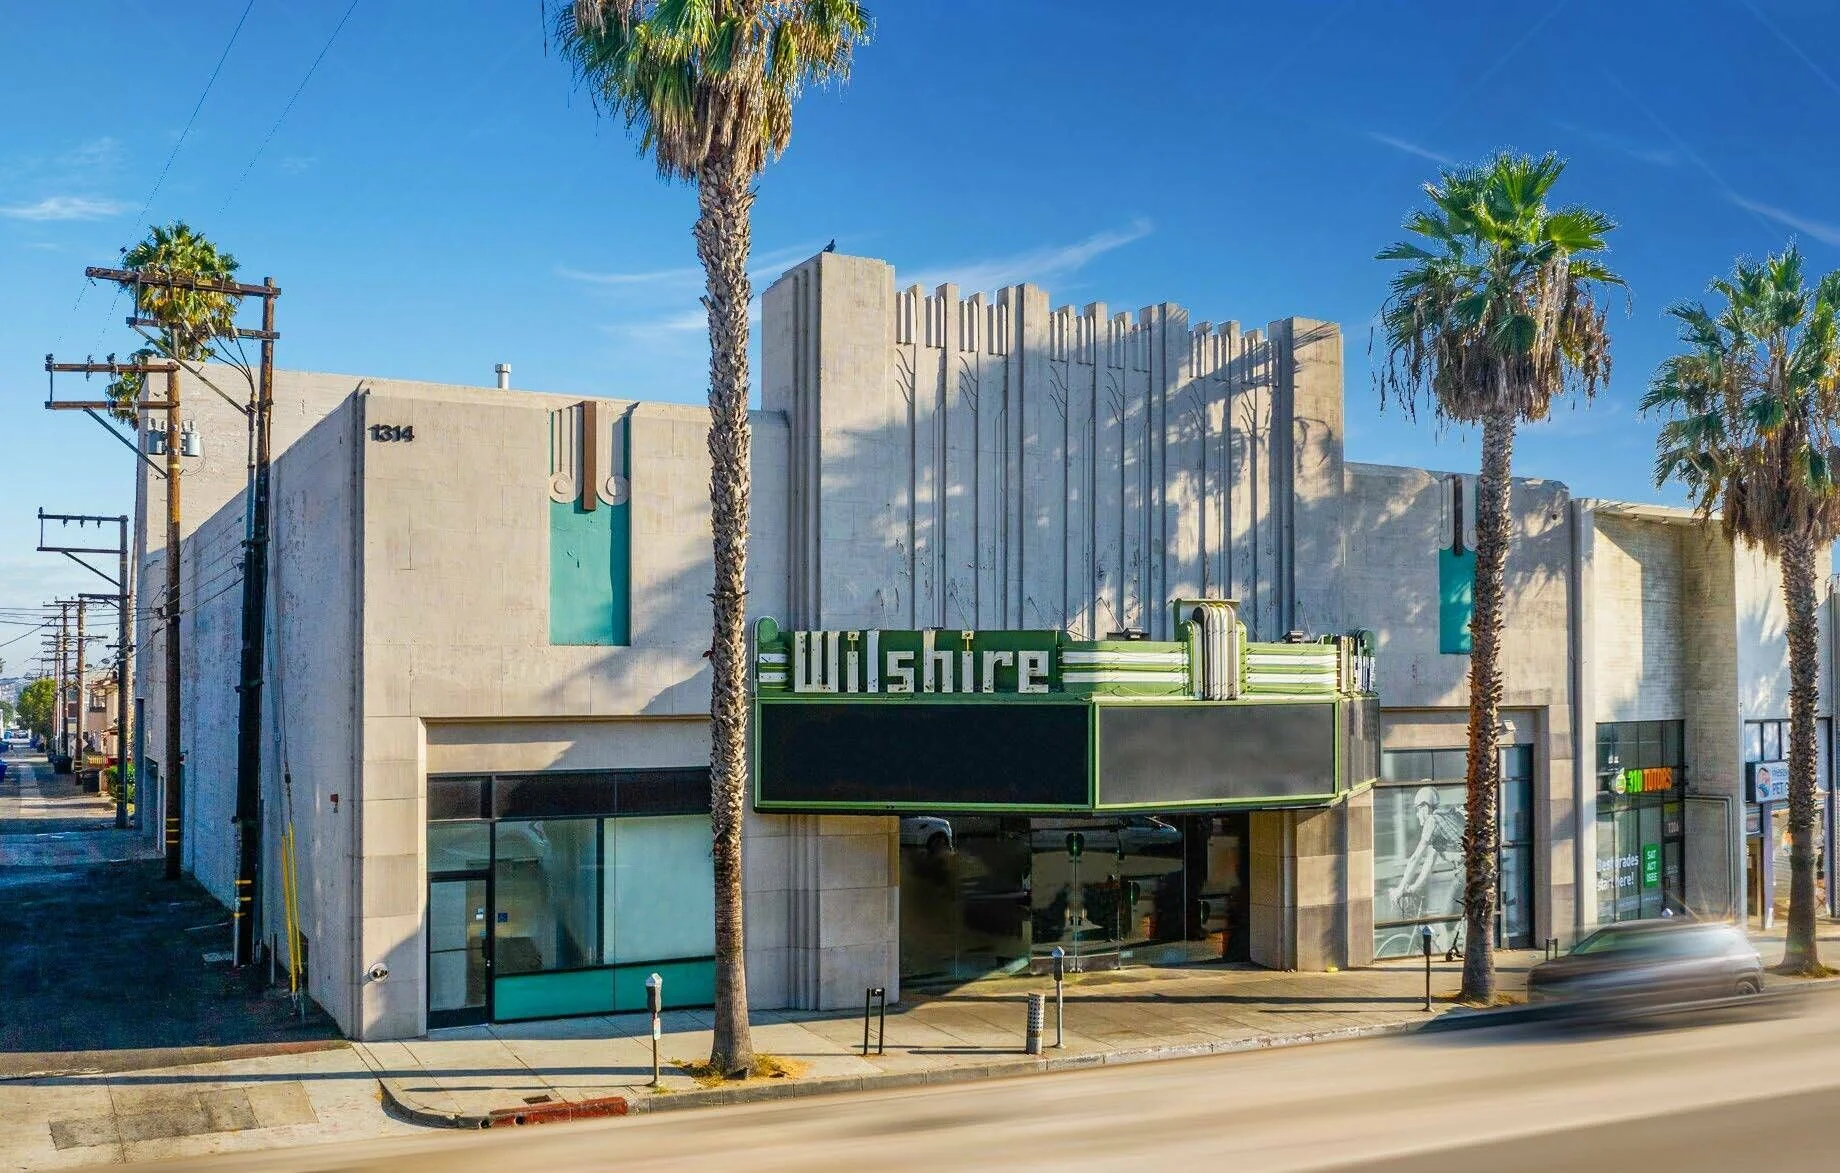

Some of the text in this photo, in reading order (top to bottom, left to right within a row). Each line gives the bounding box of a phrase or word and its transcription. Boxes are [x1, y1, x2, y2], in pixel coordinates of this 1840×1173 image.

[368, 424, 414, 442] 1314
[794, 630, 1050, 693] Wilshire
[1627, 769, 1642, 793] 310
[1643, 767, 1672, 792] TUTORS
[1647, 850, 1657, 860] SAT
